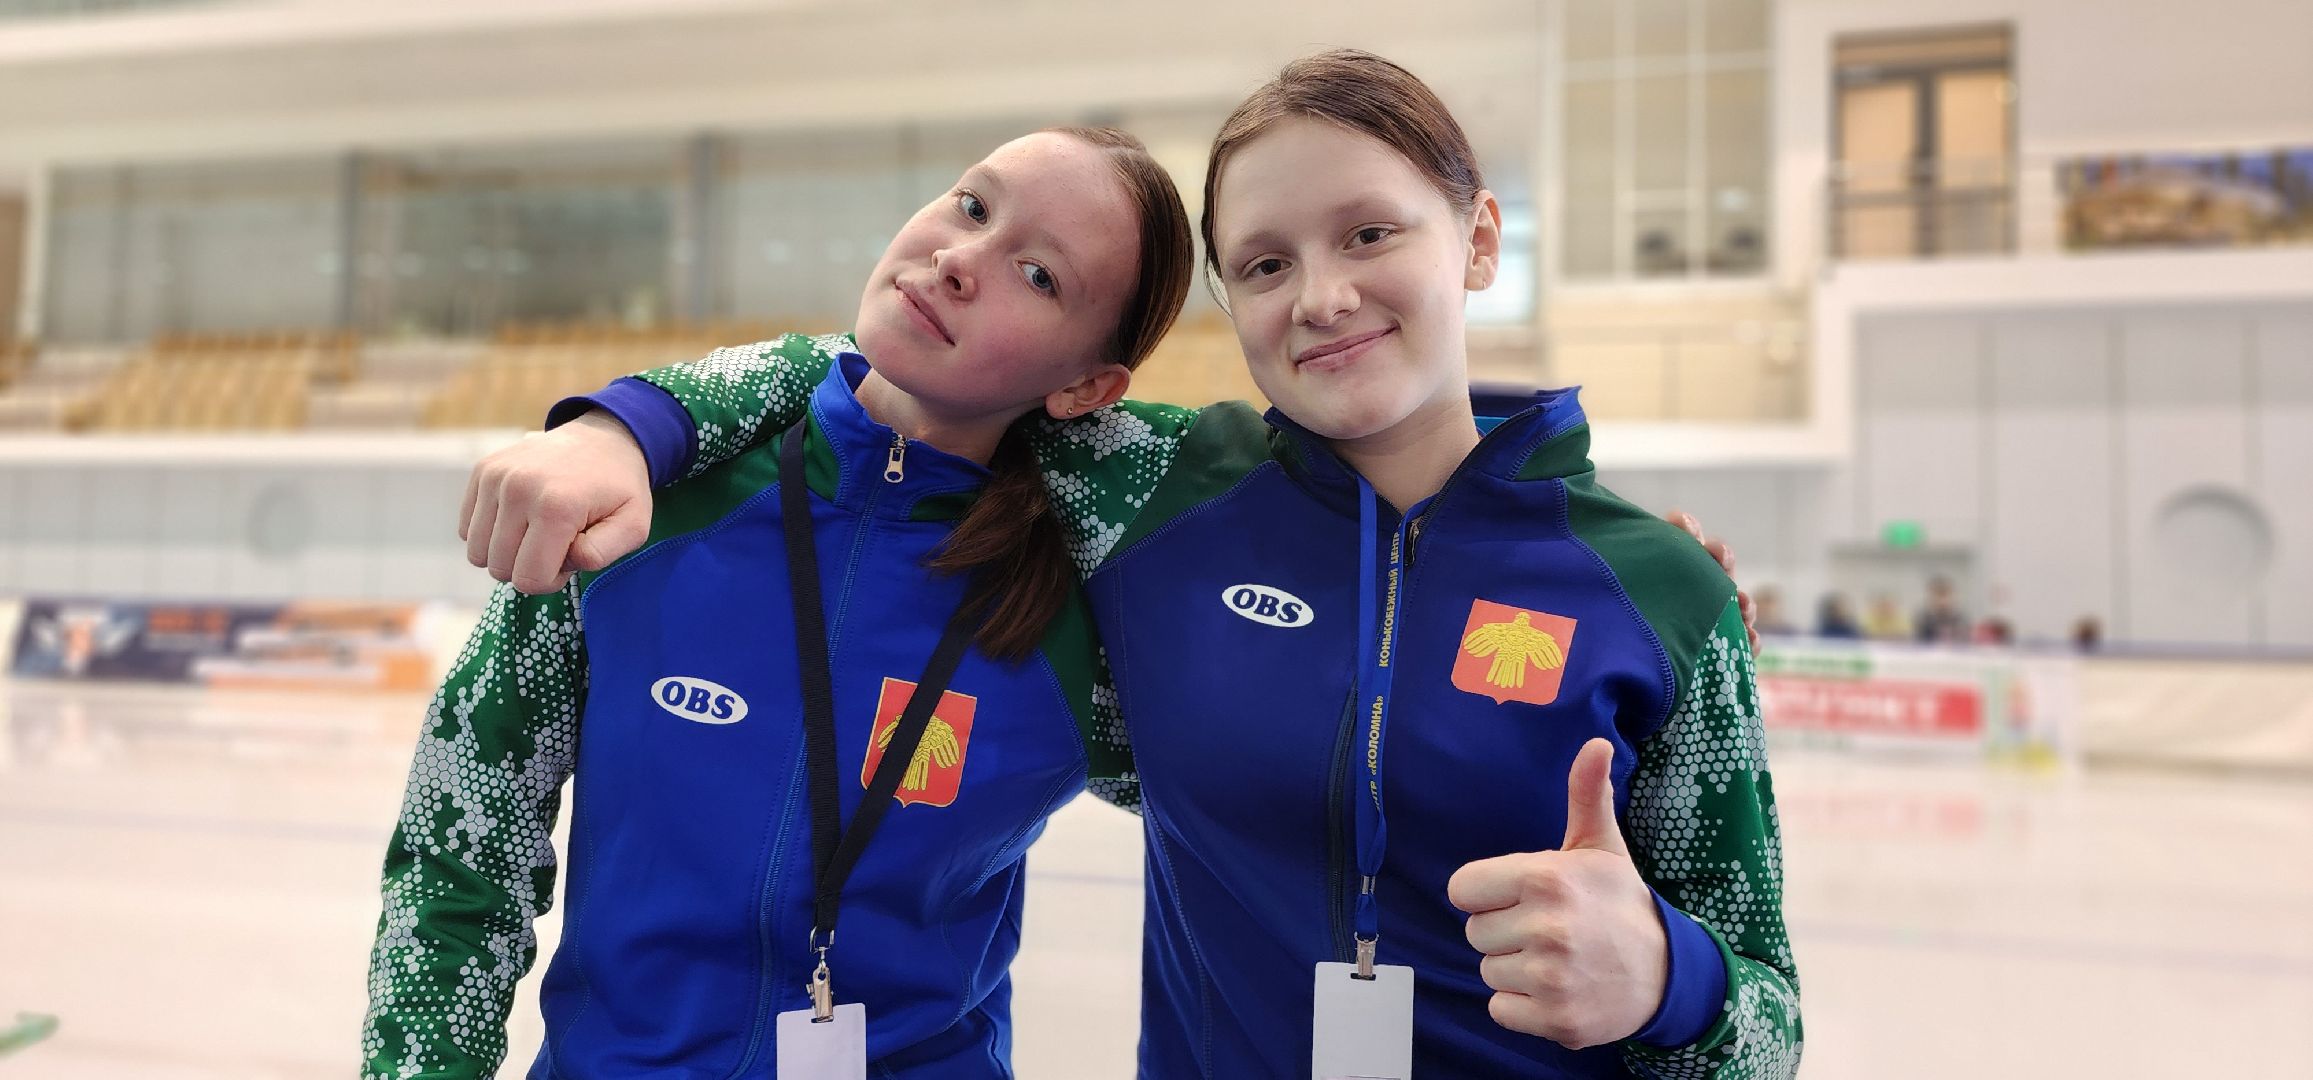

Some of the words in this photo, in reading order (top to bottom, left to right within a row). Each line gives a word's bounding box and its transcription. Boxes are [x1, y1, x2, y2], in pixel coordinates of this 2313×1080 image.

[1232, 588, 1302, 623] OBS
[1379, 568, 1399, 668] КОНЬКОБЕЖНЫЙ
[661, 680, 735, 720] OBS
[1367, 695, 1384, 776] «КОЛОМНА»
